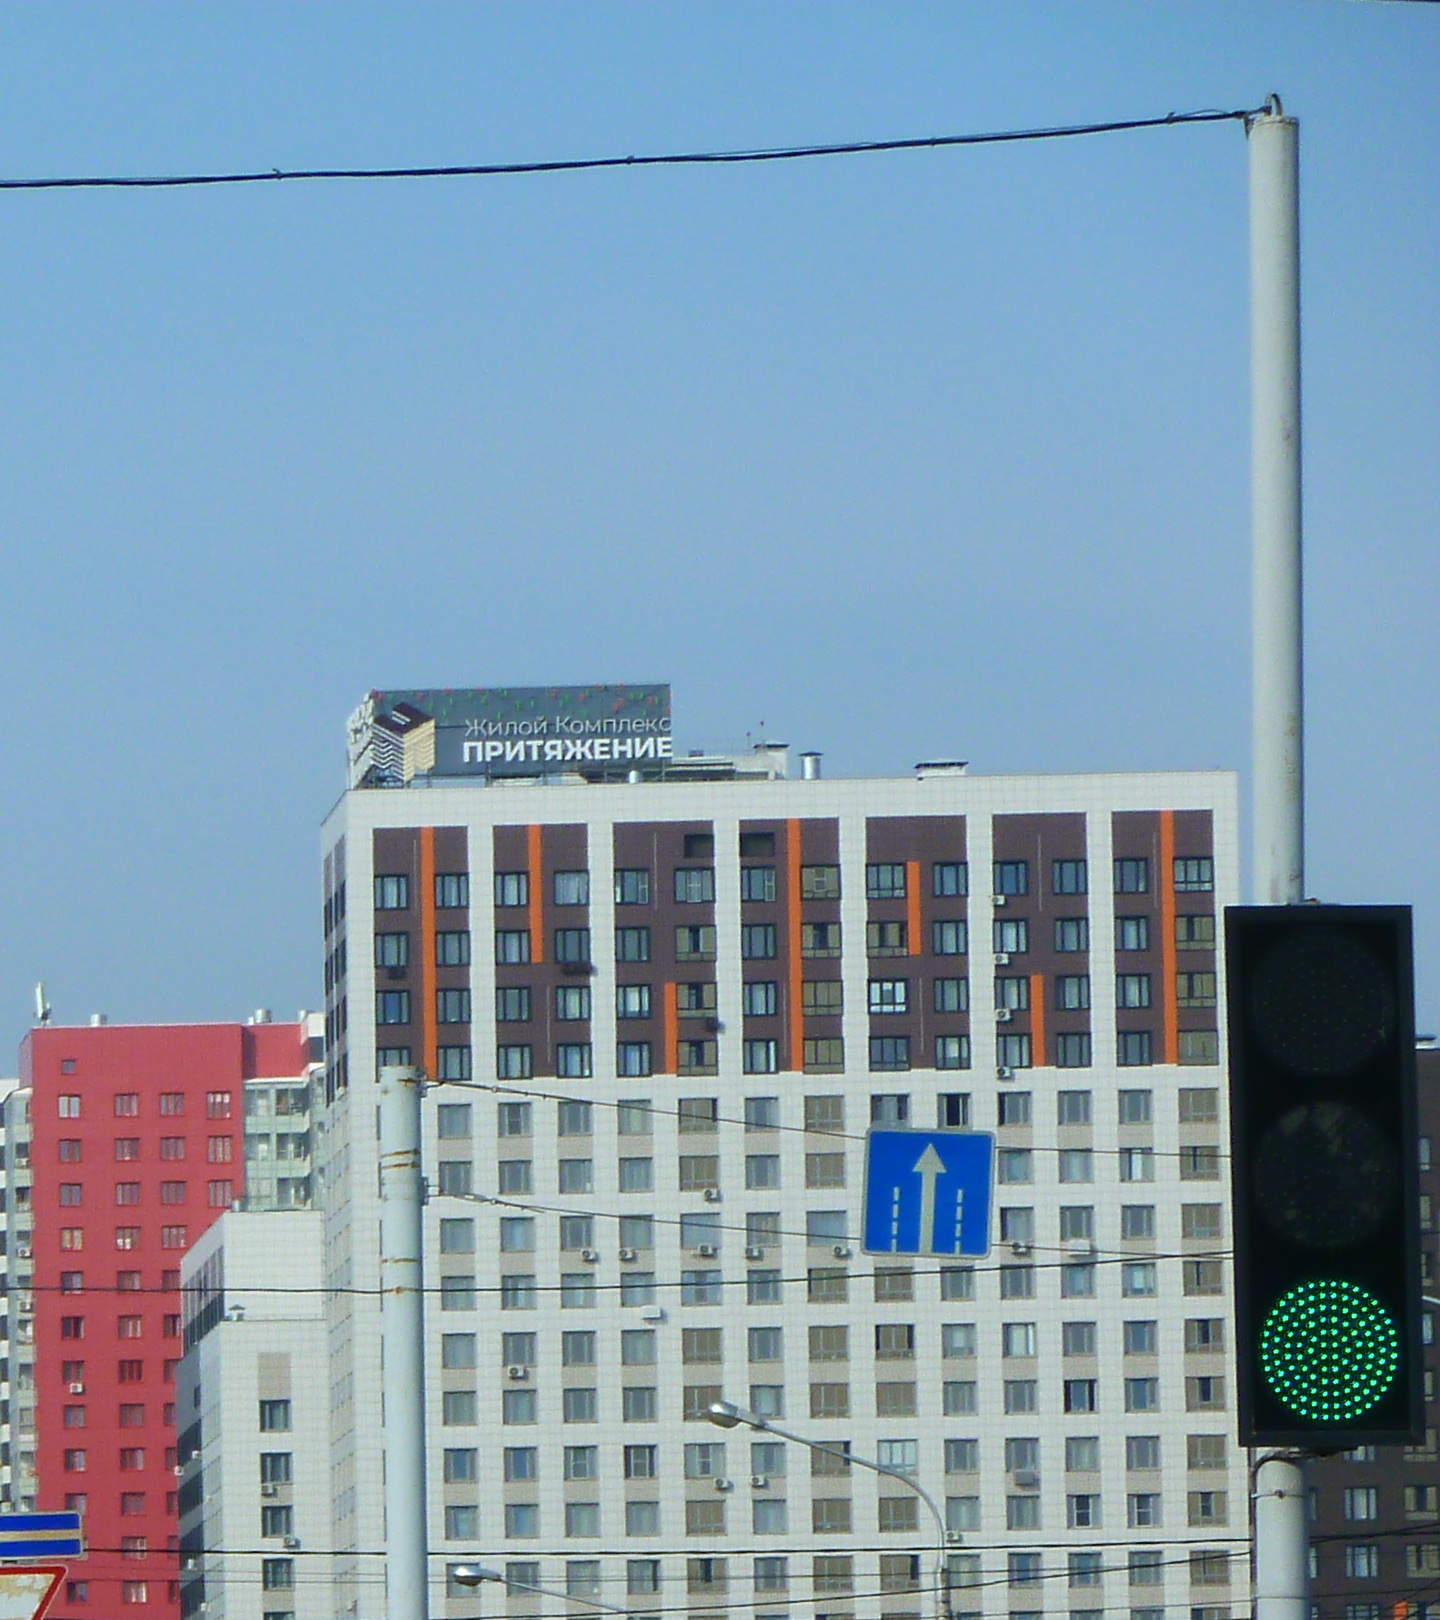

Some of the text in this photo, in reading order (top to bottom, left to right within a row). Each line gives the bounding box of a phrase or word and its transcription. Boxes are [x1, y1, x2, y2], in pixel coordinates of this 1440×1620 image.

[464, 714, 672, 737] Жилой Комплекс
[462, 736, 673, 763] ПРИТЯЖЕНИЕ
